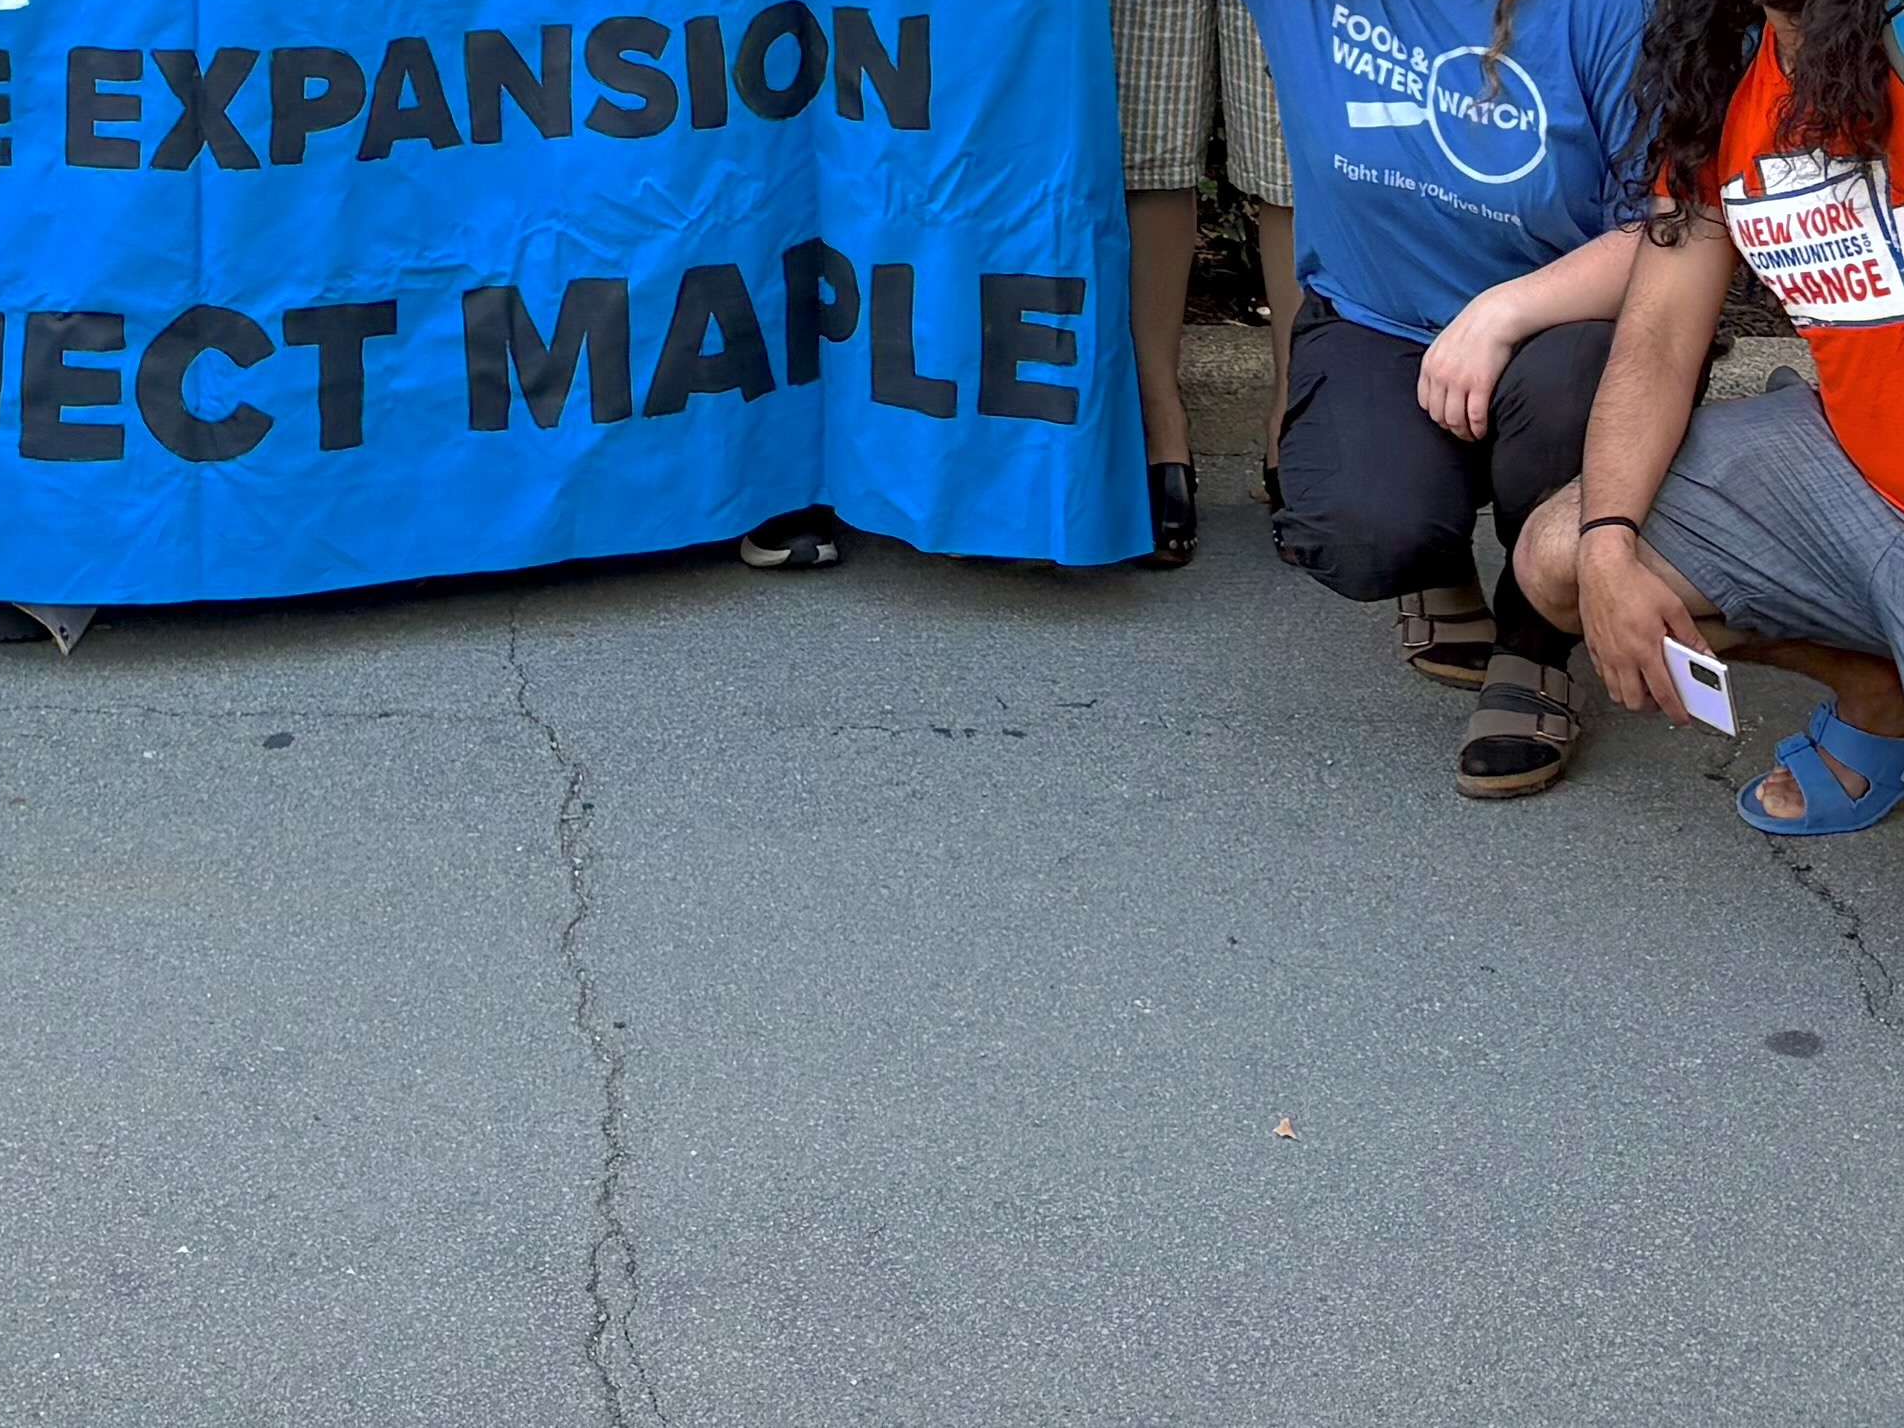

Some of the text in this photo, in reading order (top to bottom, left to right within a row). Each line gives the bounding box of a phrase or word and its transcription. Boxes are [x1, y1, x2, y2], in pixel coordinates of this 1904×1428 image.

[1332, 3, 1429, 75] FOOD &
[65, 0, 932, 171] EXPANSION
[1332, 35, 1424, 102] WATER
[1437, 85, 1536, 132] WATCH
[1333, 153, 1379, 184] Fight
[1384, 168, 1417, 191] like
[1736, 198, 1864, 248] NEW YORK
[1749, 236, 1863, 270] COMMUNITIES
[462, 236, 1086, 432] MAPLE
